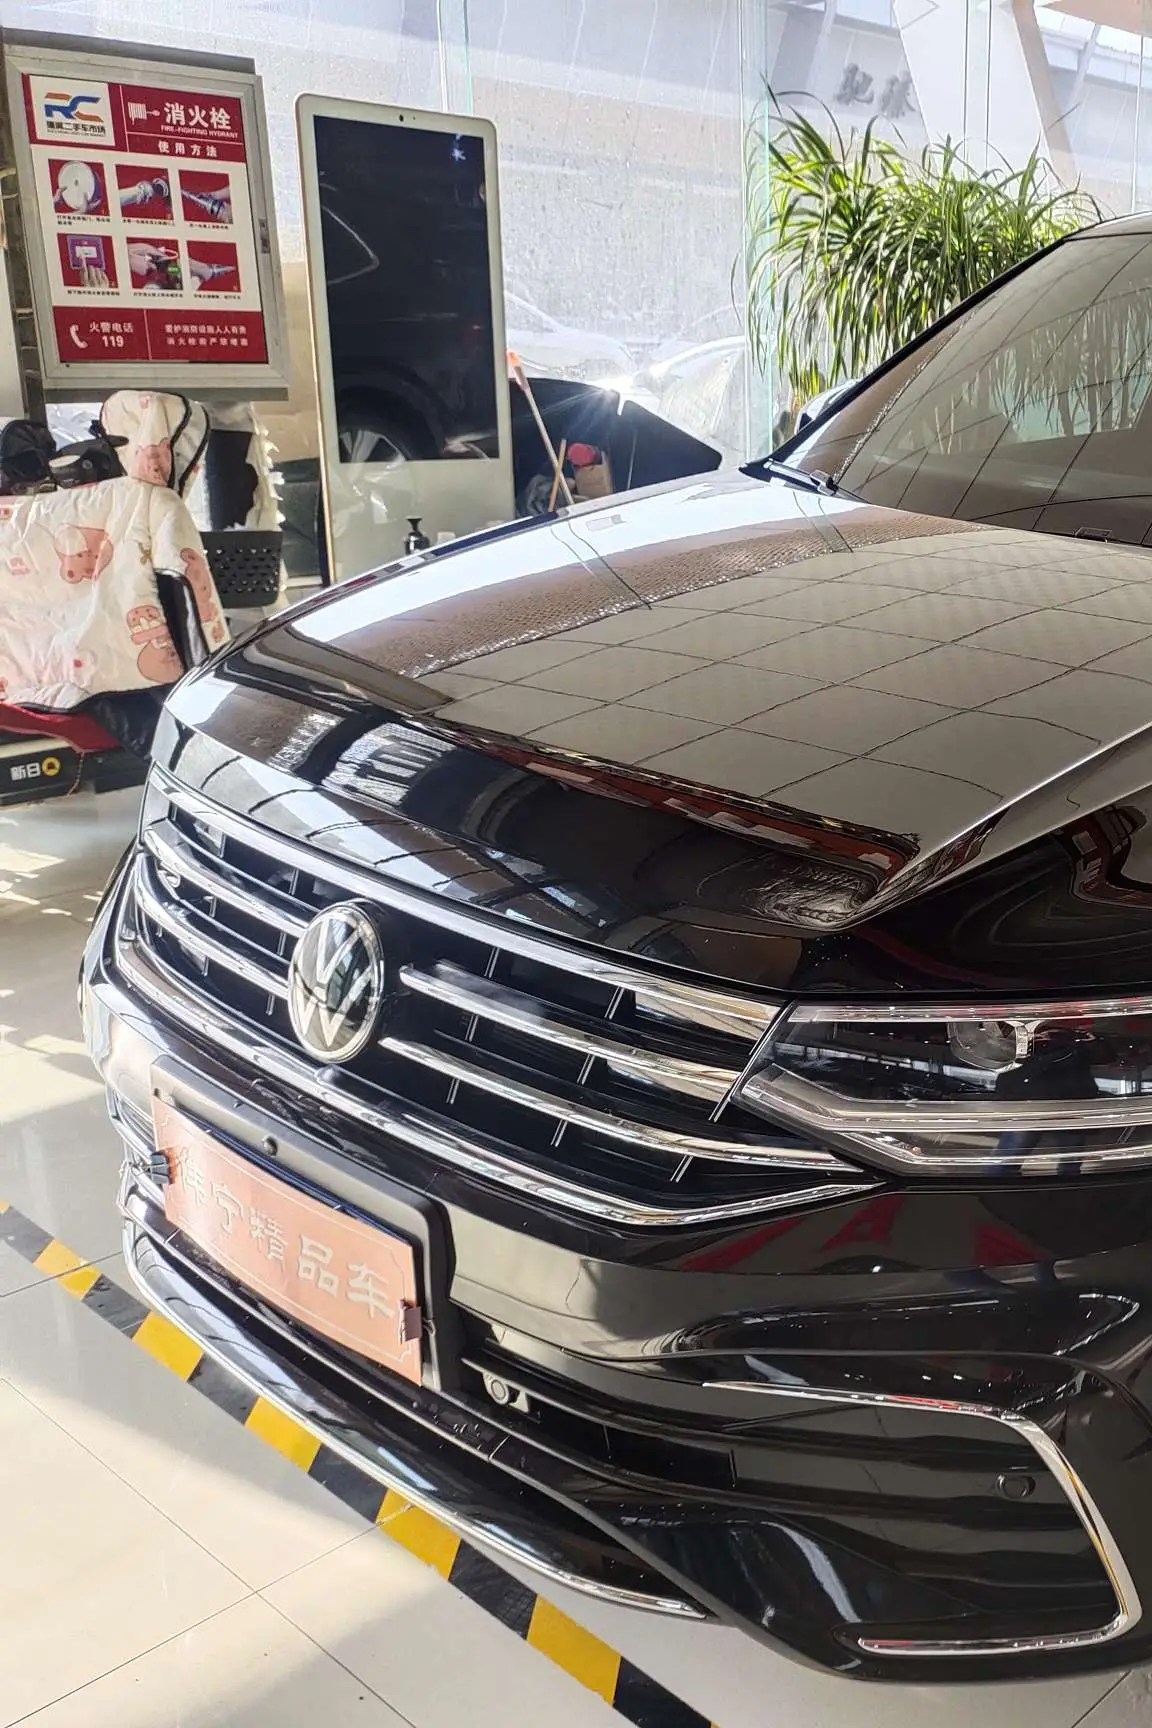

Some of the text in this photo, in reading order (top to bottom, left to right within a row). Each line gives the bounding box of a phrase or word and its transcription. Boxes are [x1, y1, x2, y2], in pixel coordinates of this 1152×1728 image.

[164, 102, 231, 130] 消火栓
[161, 125, 238, 138] FIRE-FIGHTING HYDRANT
[158, 140, 217, 157] 使用方法
[90, 321, 134, 334] 火警电话
[102, 335, 124, 348] 119
[10, 762, 41, 781] 新日
